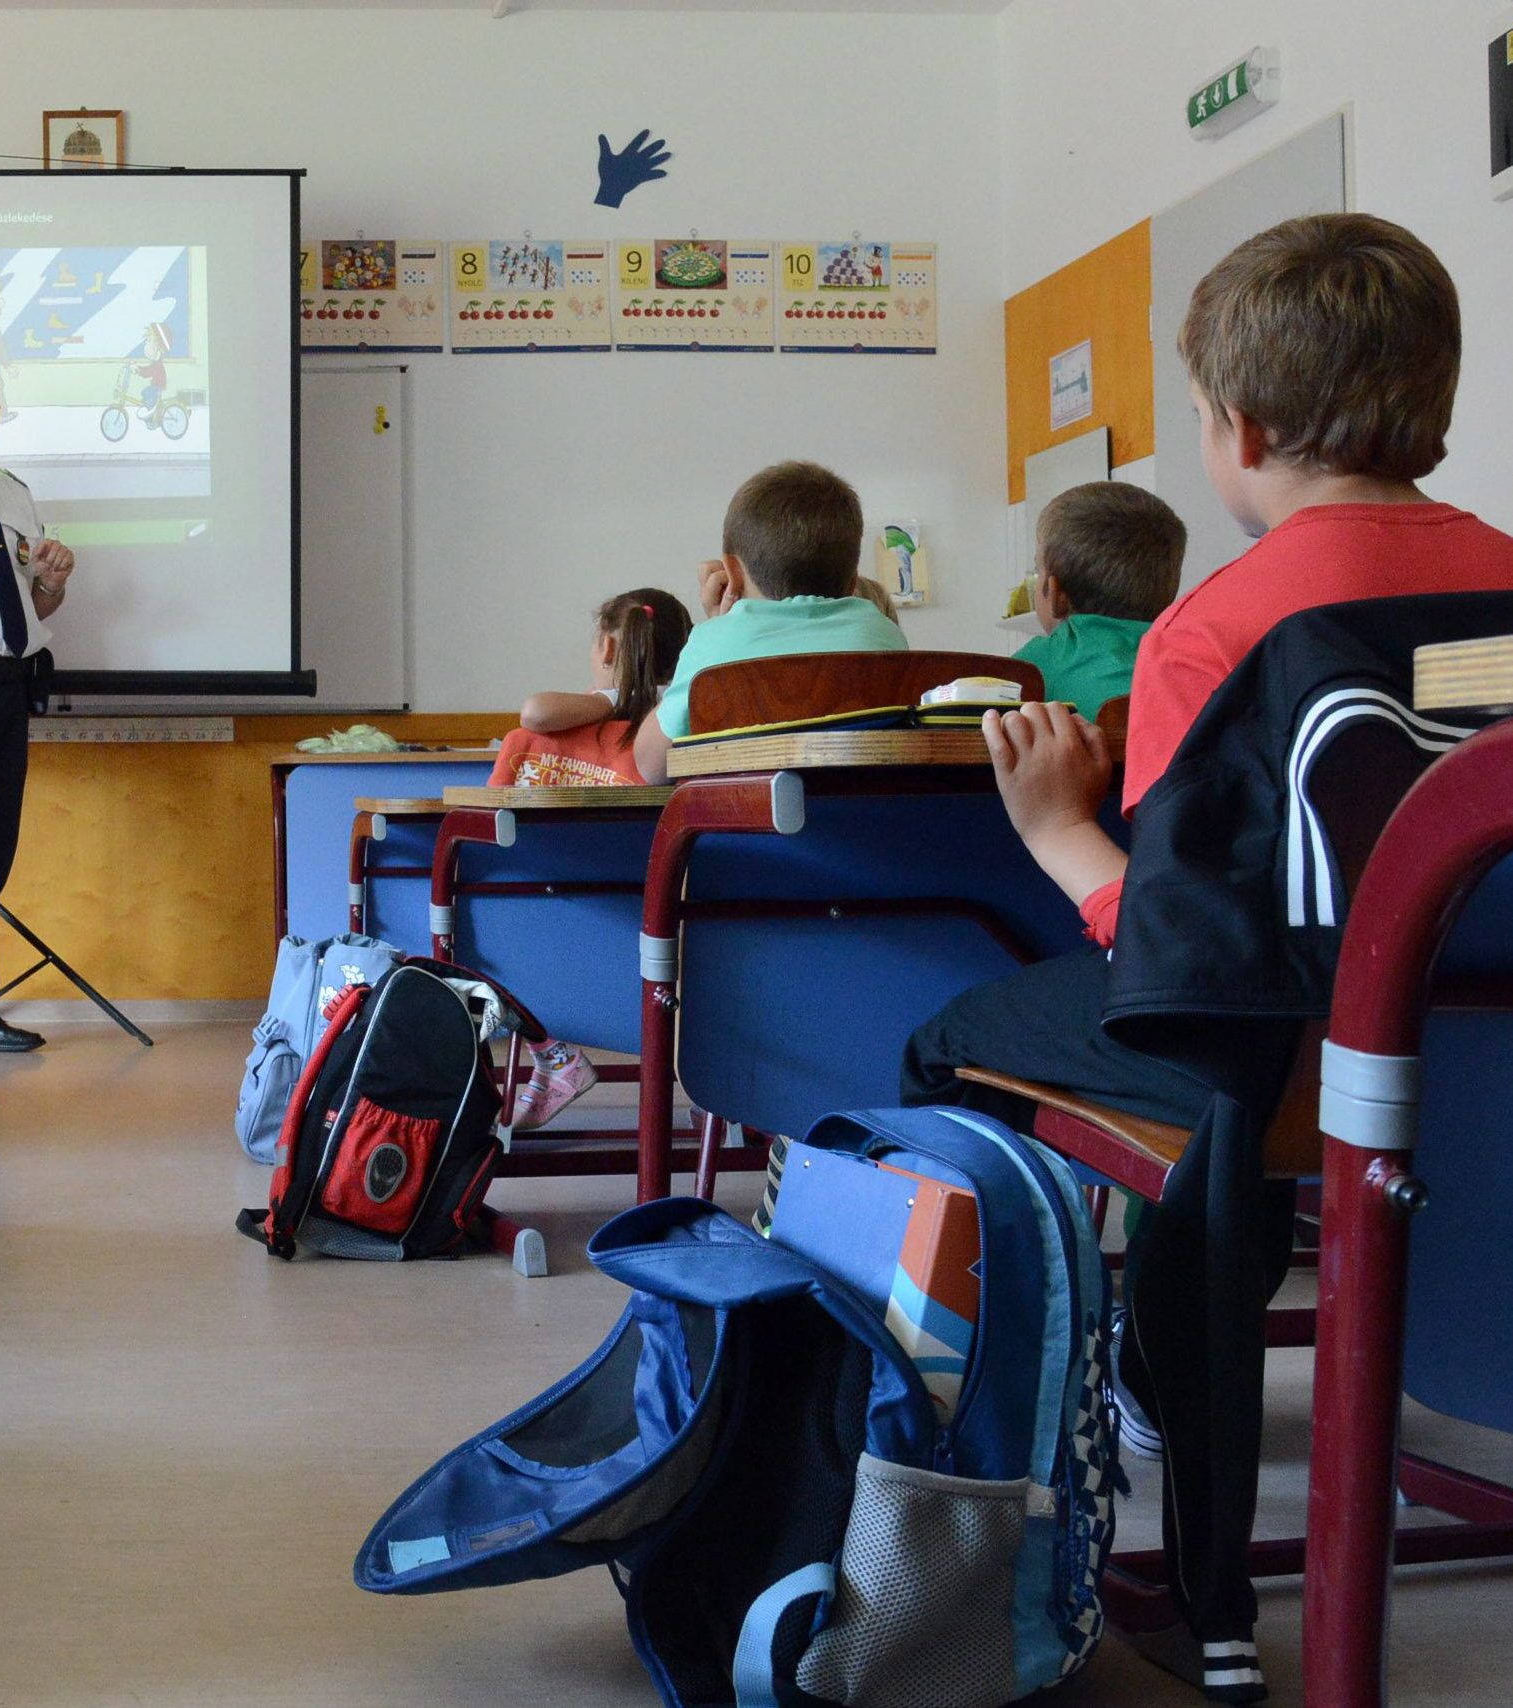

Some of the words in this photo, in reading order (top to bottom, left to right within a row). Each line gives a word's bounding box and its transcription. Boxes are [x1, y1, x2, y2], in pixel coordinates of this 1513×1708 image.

[300, 251, 309, 271] 7
[461, 252, 478, 275] 8
[626, 250, 642, 273] 9
[785, 254, 811, 275] 10
[540, 753, 559, 767] MY
[561, 757, 617, 784] FAVOURITE
